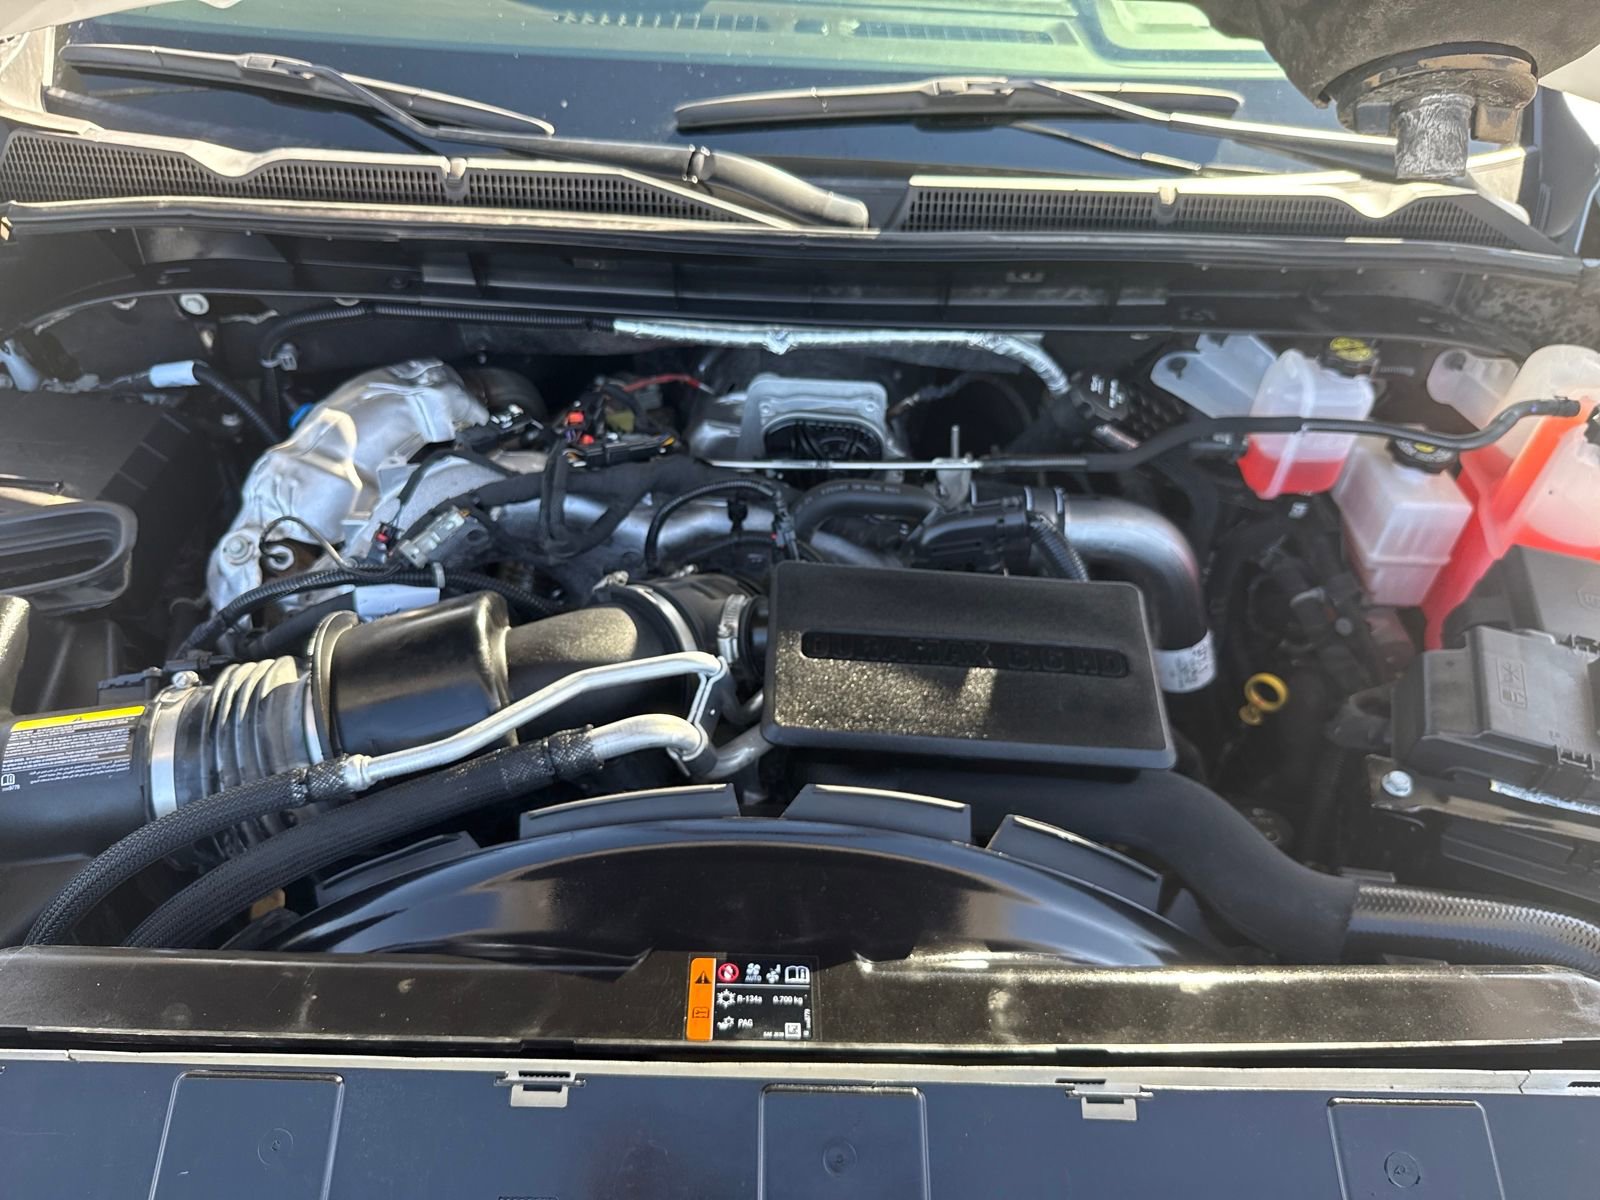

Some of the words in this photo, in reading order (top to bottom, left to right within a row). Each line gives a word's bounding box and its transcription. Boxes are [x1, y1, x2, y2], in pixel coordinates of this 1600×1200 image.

[813, 635, 993, 667] DURAMAX
[745, 975, 762, 983] AUTO
[736, 995, 763, 1004] R-134a
[772, 995, 793, 1005] 0.700
[794, 996, 804, 1006] kg
[738, 1018, 754, 1029] PAG
